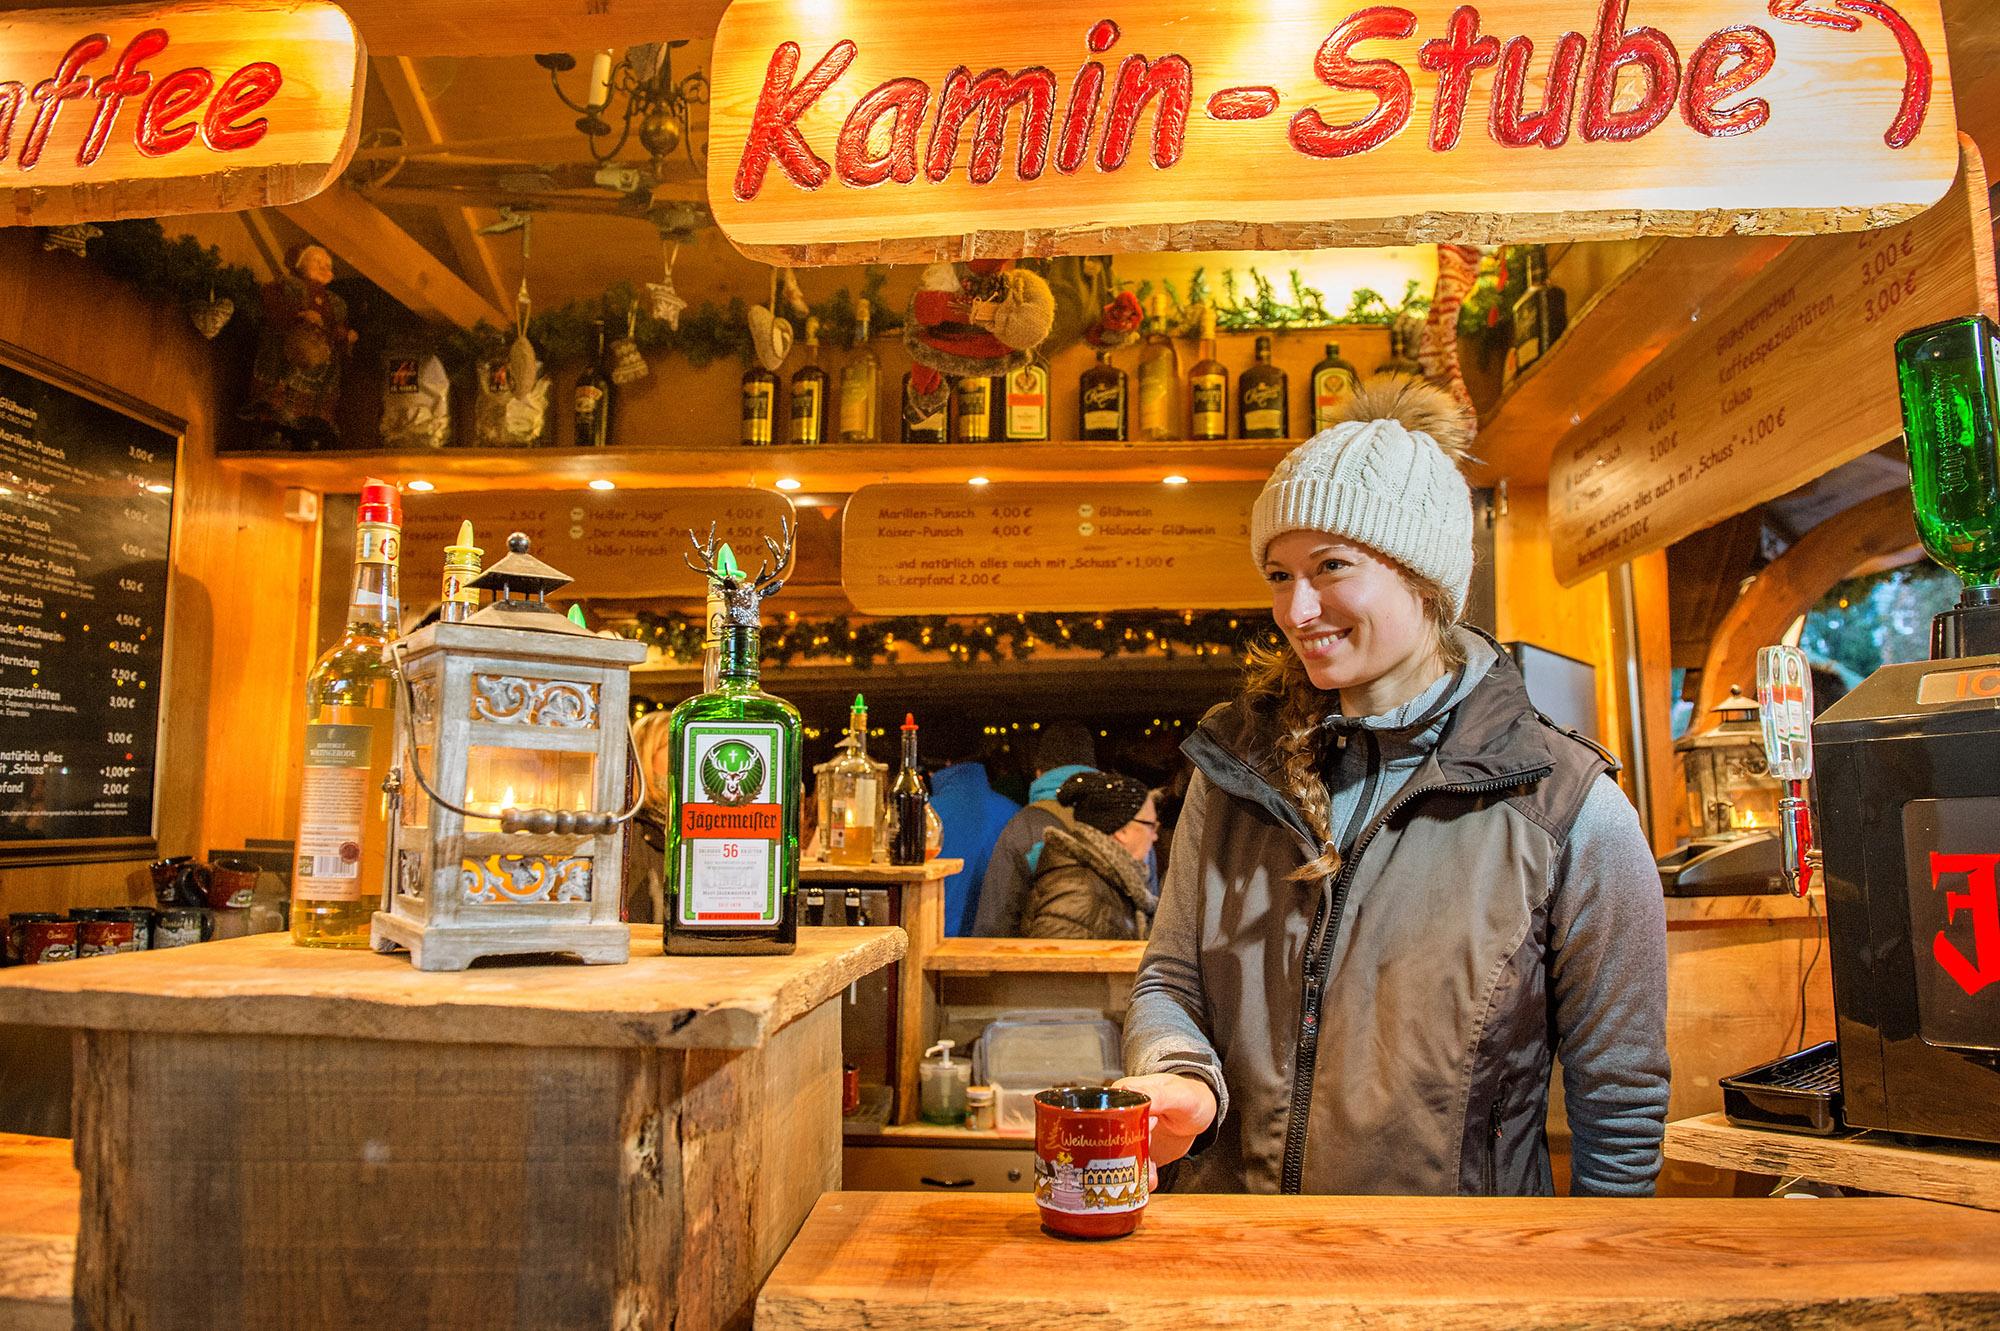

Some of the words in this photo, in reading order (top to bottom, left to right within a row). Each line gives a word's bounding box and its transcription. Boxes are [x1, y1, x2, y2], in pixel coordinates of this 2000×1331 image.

[733, 0, 1777, 201] Kamin-Stube
[879, 507, 976, 520] Marillen-Punsch
[991, 507, 1021, 519] 4,00
[1099, 505, 1153, 517] Glühwein
[878, 526, 965, 538] Kaiser-Punsch
[991, 525, 1021, 537] 4,00
[921, 557, 975, 569] natürlich
[980, 557, 1008, 569] alles
[1012, 557, 1041, 569] auch
[1046, 558, 1066, 569] mit
[959, 573, 989, 586] 2,00
[13, 593, 43, 608] Hirsch
[43, 751, 64, 763] alles
[722, 843, 739, 858] 56
